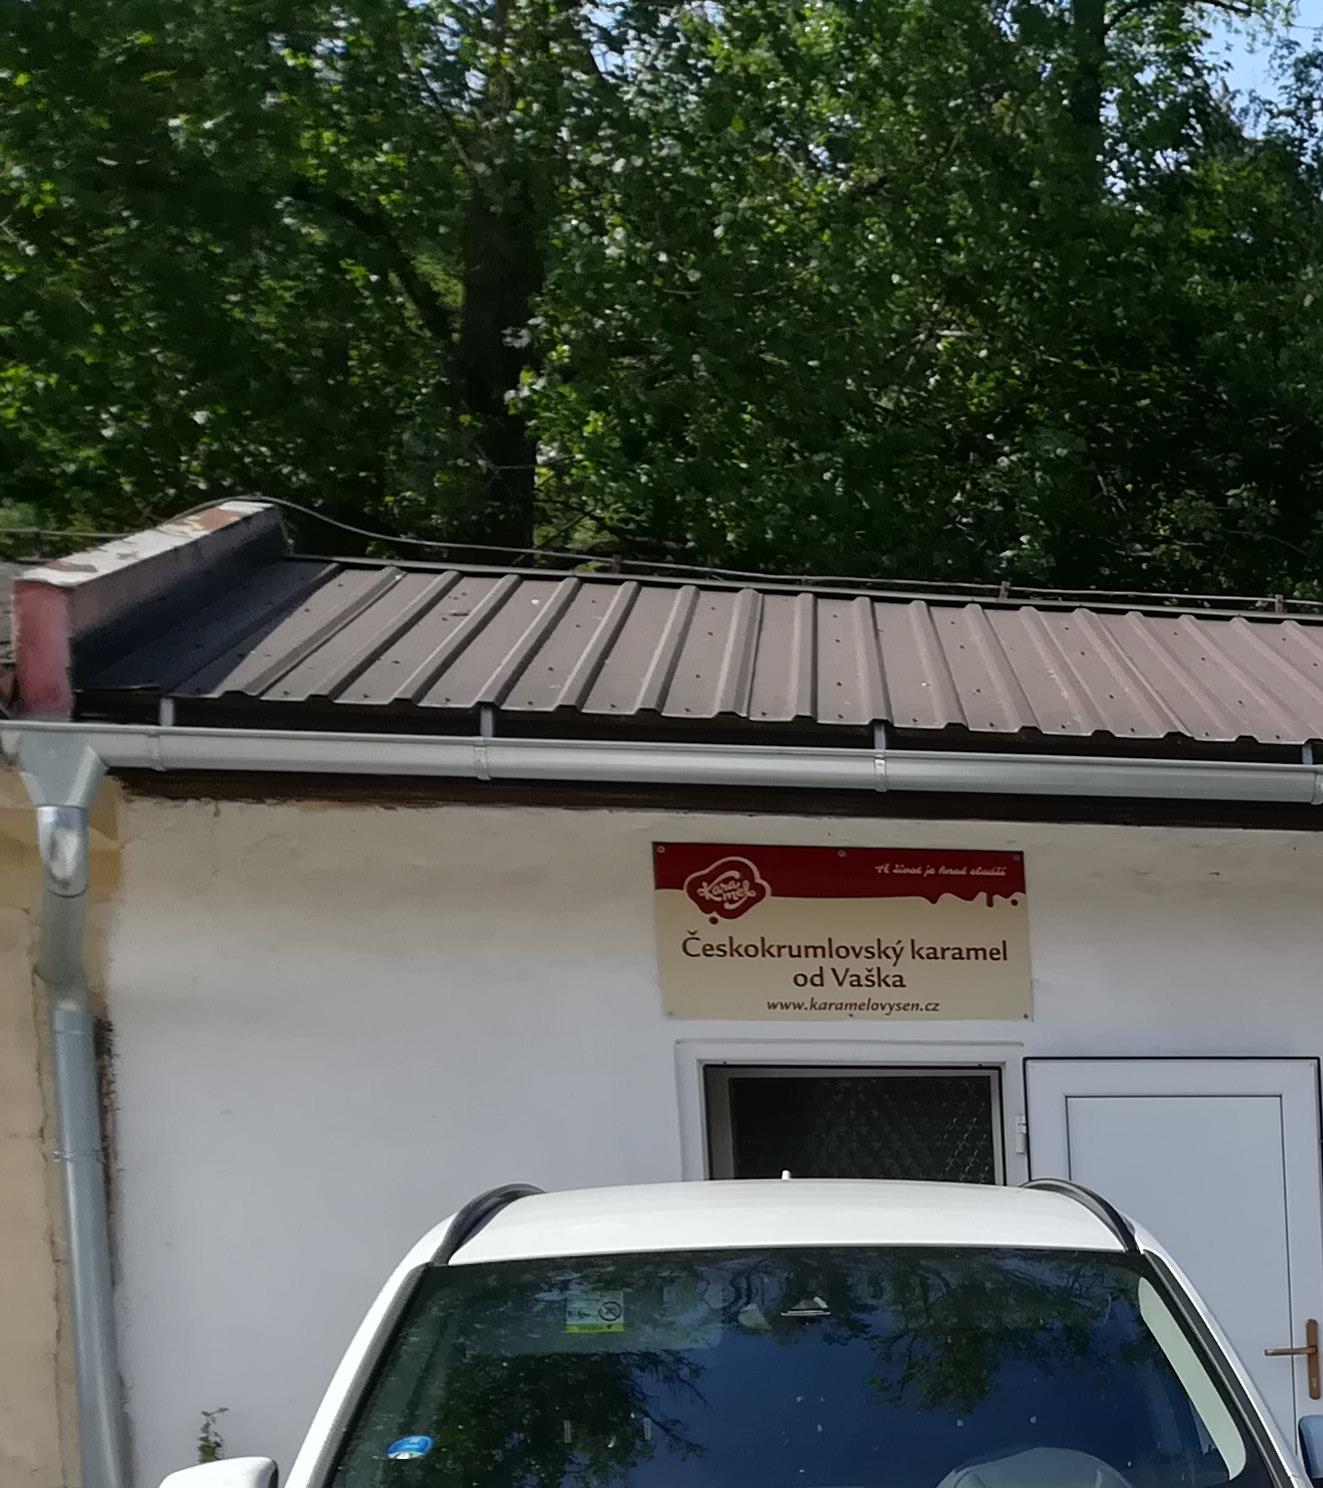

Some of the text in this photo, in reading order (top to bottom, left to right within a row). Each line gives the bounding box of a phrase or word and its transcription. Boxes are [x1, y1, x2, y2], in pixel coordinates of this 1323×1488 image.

[681, 930, 1008, 967] Českokrumlovský karamel
[793, 966, 907, 988] od Vaška
[767, 997, 941, 1016] www.karamelovysen.cz
